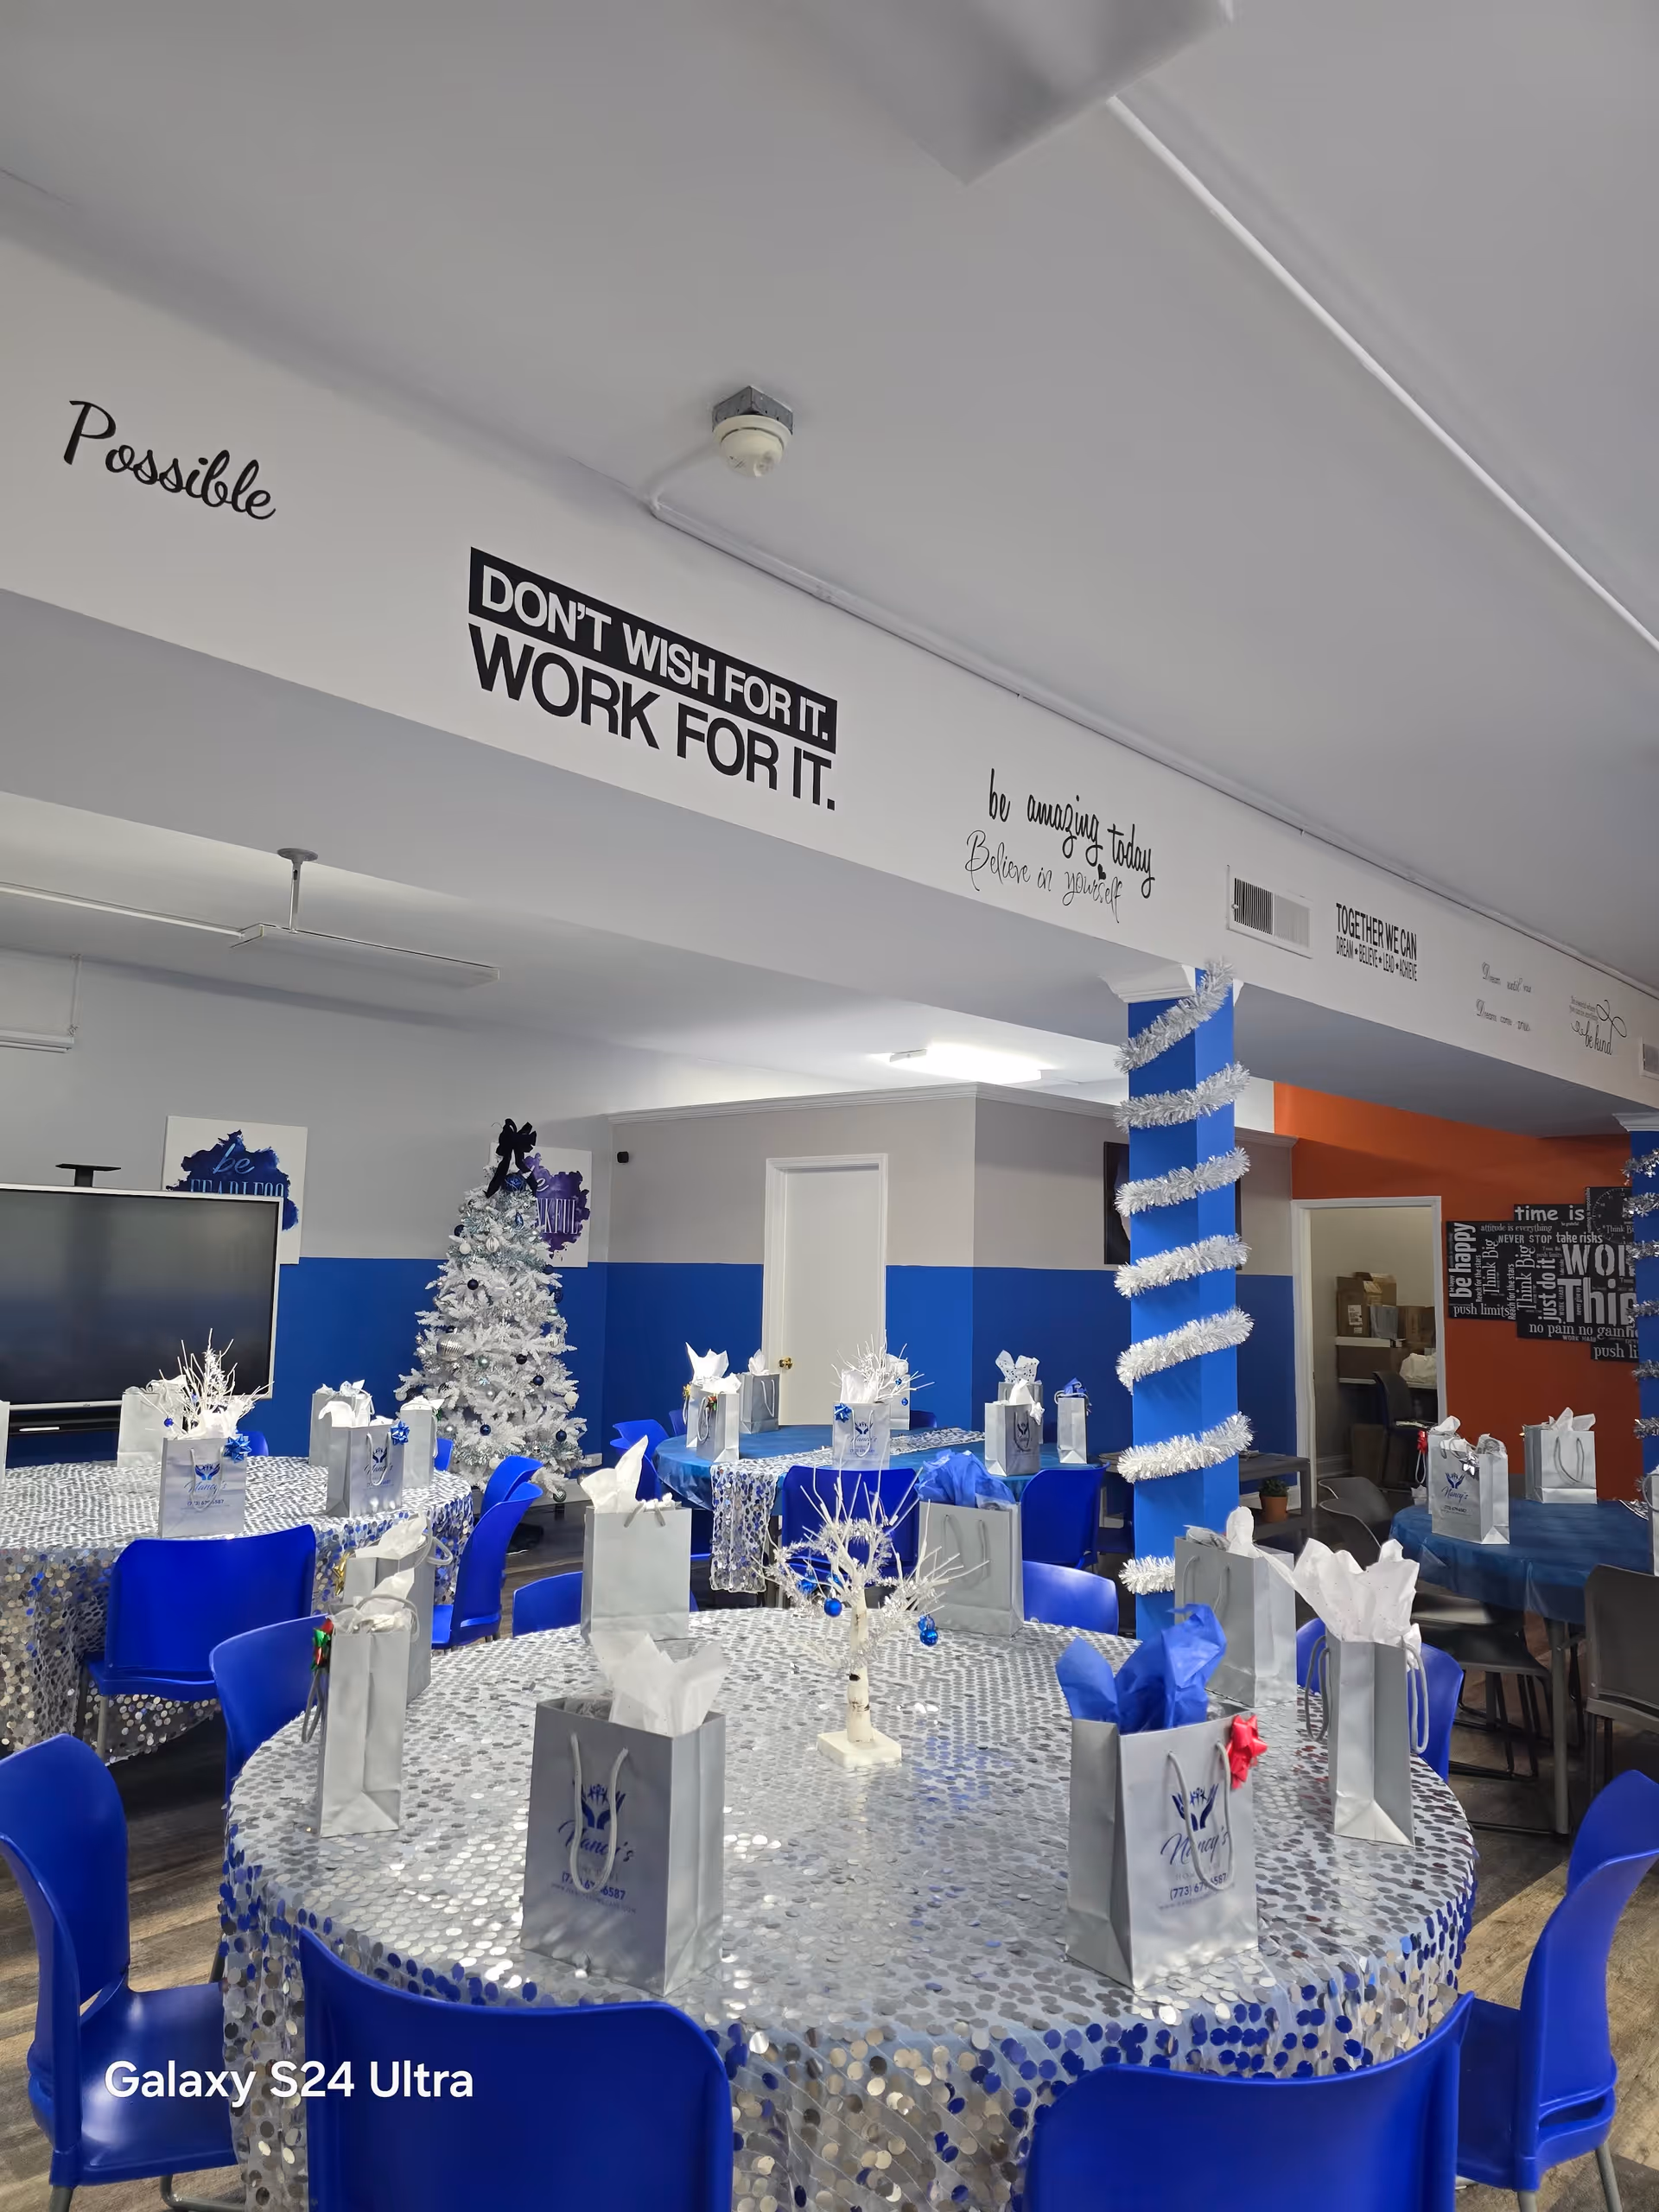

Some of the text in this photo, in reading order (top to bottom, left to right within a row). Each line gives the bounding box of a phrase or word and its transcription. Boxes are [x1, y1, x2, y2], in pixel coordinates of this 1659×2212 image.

[64, 400, 276, 519] Possible
[482, 564, 829, 741] DON'T WISH FOR IT.
[468, 623, 835, 810] WORK FOR IT.
[989, 768, 1155, 899] be amazing today
[965, 830, 1122, 924] Believe in yourself
[1336, 903, 1416, 961] TOGETHER WE CAN
[1337, 935, 1353, 959] DREAM
[1359, 944, 1377, 968] BELIEVE
[1383, 952, 1395, 973] LEAD
[213, 1143, 254, 1174] be
[1515, 1205, 1585, 1221] time is
[1480, 1224, 1505, 1232] attitude
[1516, 1224, 1553, 1233] everything
[1556, 1231, 1603, 1243] take risks
[1606, 1225, 1624, 1234] Think
[1482, 1239, 1499, 1258] Big
[1498, 1235, 1552, 1243] NEVER STOP
[1448, 1222, 1477, 1298] be happy
[1516, 1244, 1535, 1268] Big
[1536, 1258, 1555, 1268] it
[1482, 1262, 1499, 1294] Think
[1536, 1273, 1556, 1289] do
[1507, 1293, 1516, 1302] for
[1516, 1273, 1536, 1310] Think
[1453, 1303, 1510, 1317] push limits
[1507, 1302, 1516, 1319] Reach
[1538, 1294, 1561, 1324] just
[1529, 1324, 1543, 1333] no
[1548, 1321, 1574, 1337] pain
[1579, 1326, 1592, 1335] no
[1598, 1325, 1625, 1340] gain
[1593, 1344, 1624, 1360] push
[1170, 1886, 1192, 1900] (773)
